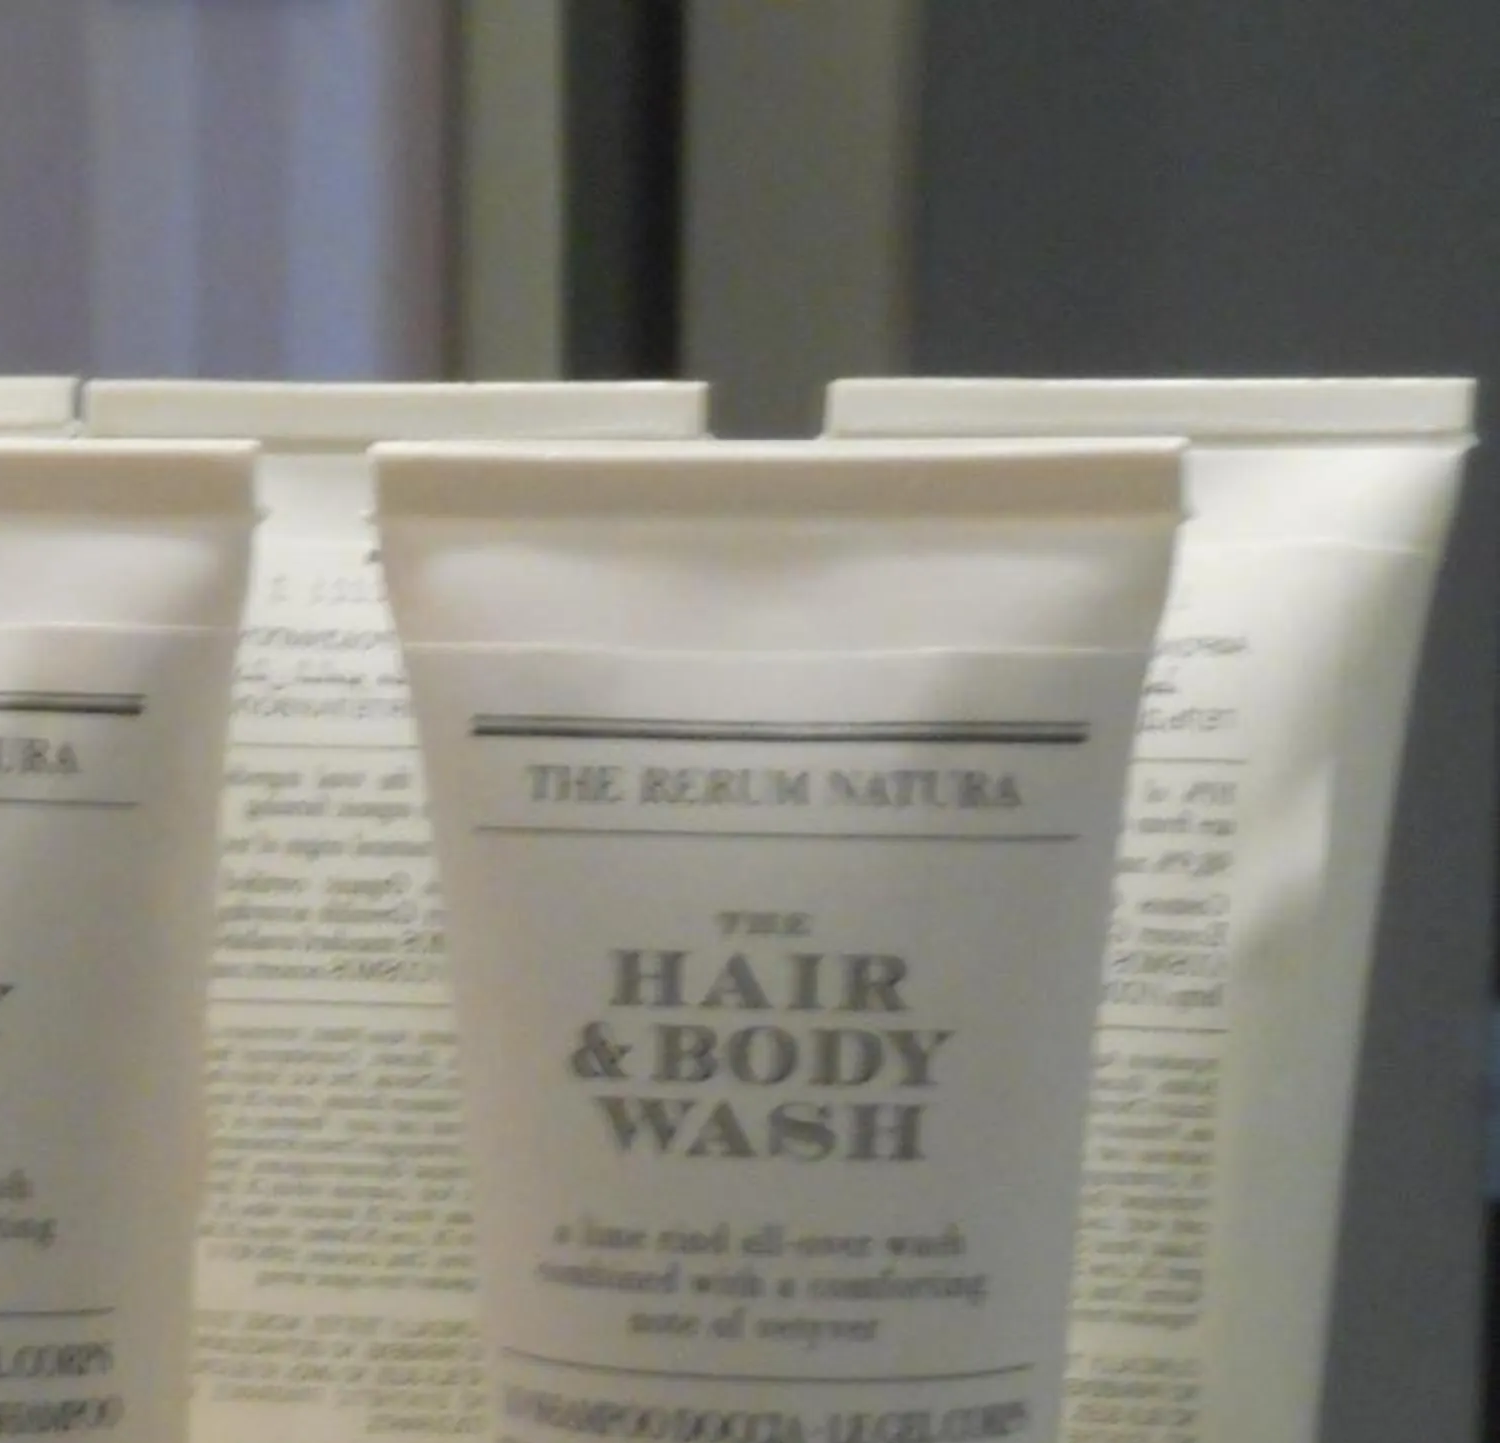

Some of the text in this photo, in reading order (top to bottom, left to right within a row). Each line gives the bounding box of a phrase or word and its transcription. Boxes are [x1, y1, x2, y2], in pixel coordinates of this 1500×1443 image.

[525, 763, 1024, 810] THE RERUM NATURA
[713, 910, 813, 938] THE
[608, 949, 910, 1013] HAIR
[651, 1022, 958, 1089] BODY
[593, 1095, 926, 1163] WASH
[883, 1222, 968, 1258] wash
[689, 1267, 766, 1300] with
[705, 1305, 748, 1340] of
